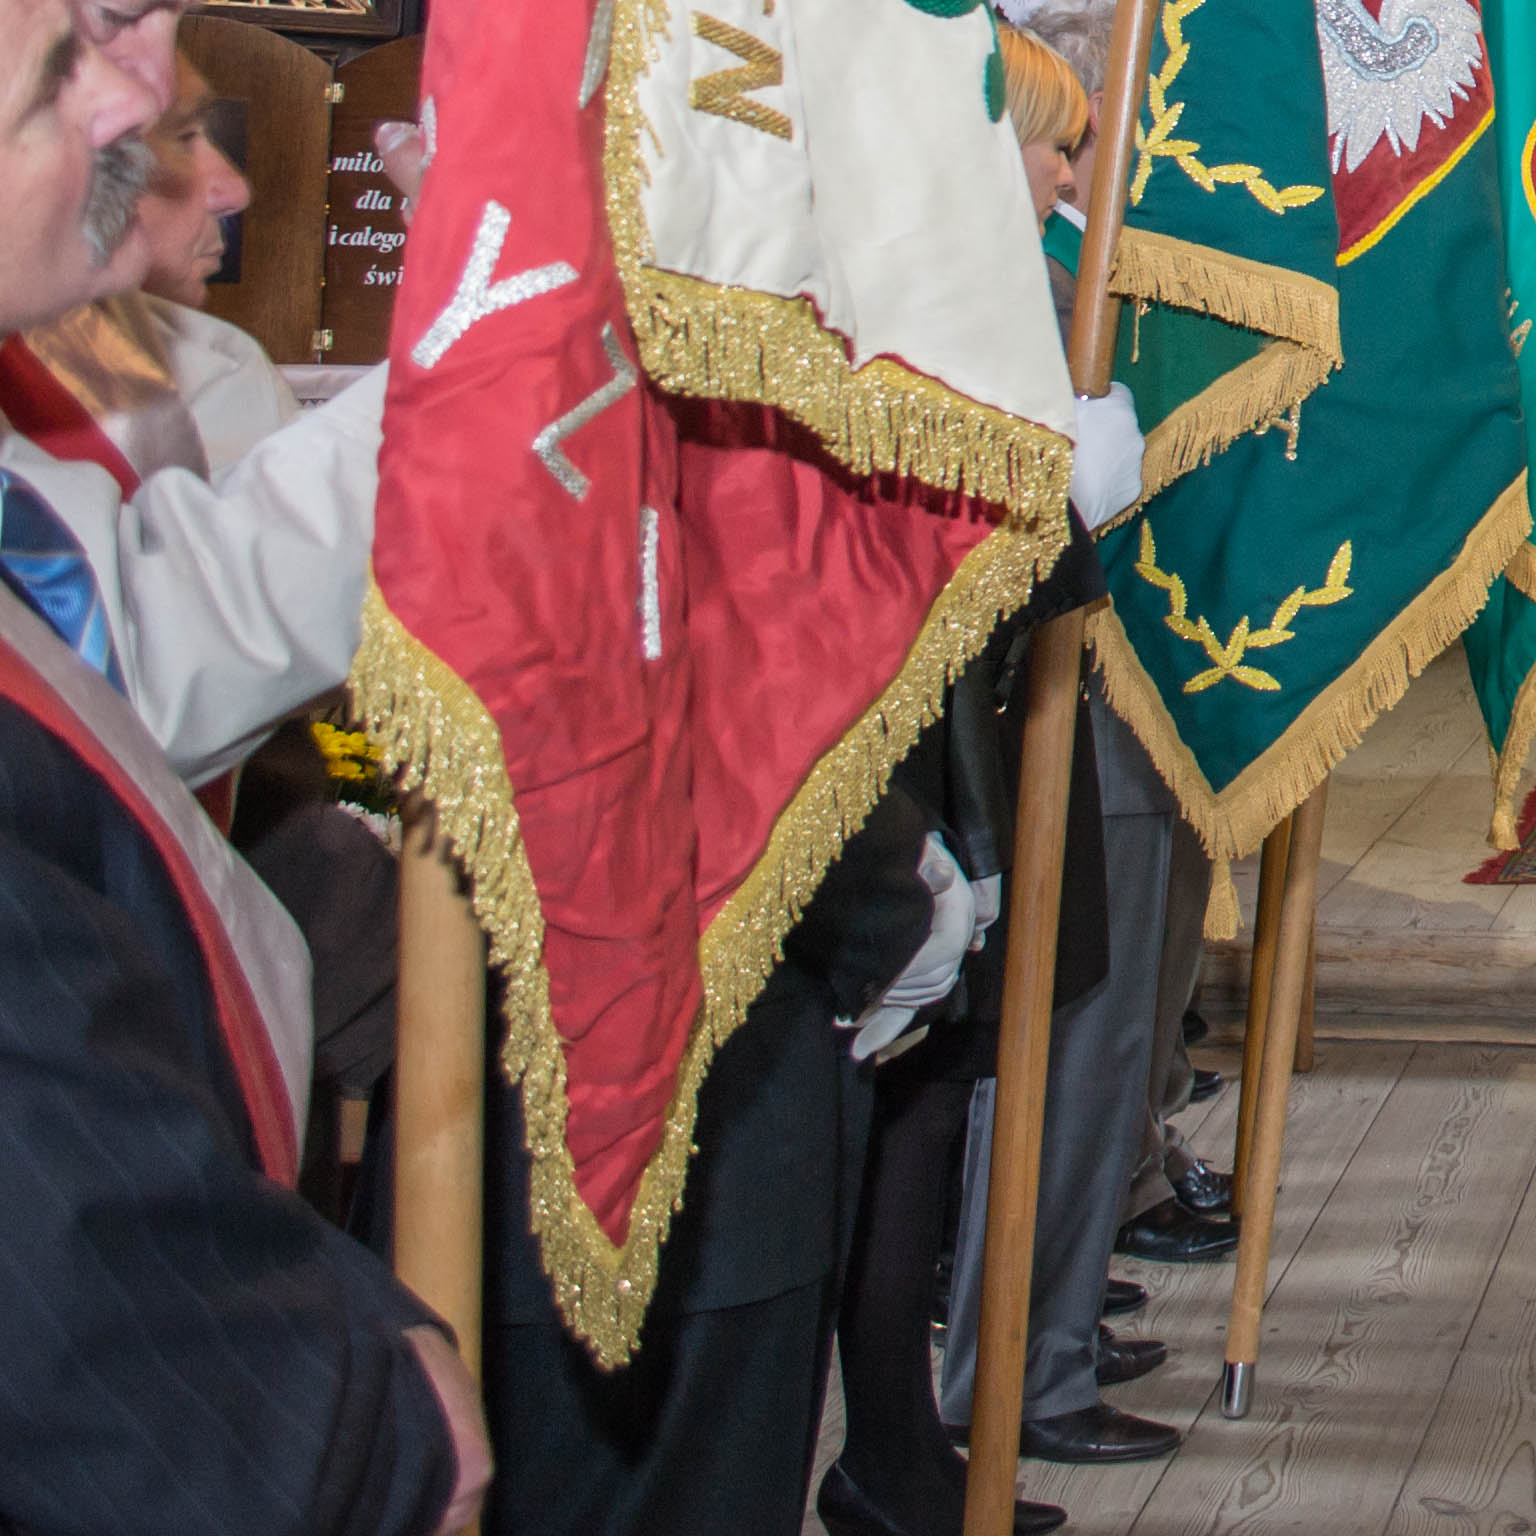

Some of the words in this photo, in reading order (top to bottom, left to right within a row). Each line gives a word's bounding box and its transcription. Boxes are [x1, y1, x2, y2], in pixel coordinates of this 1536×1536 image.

[333, 152, 384, 173] miło
[355, 189, 392, 210] dla
[364, 265, 405, 285] świ
